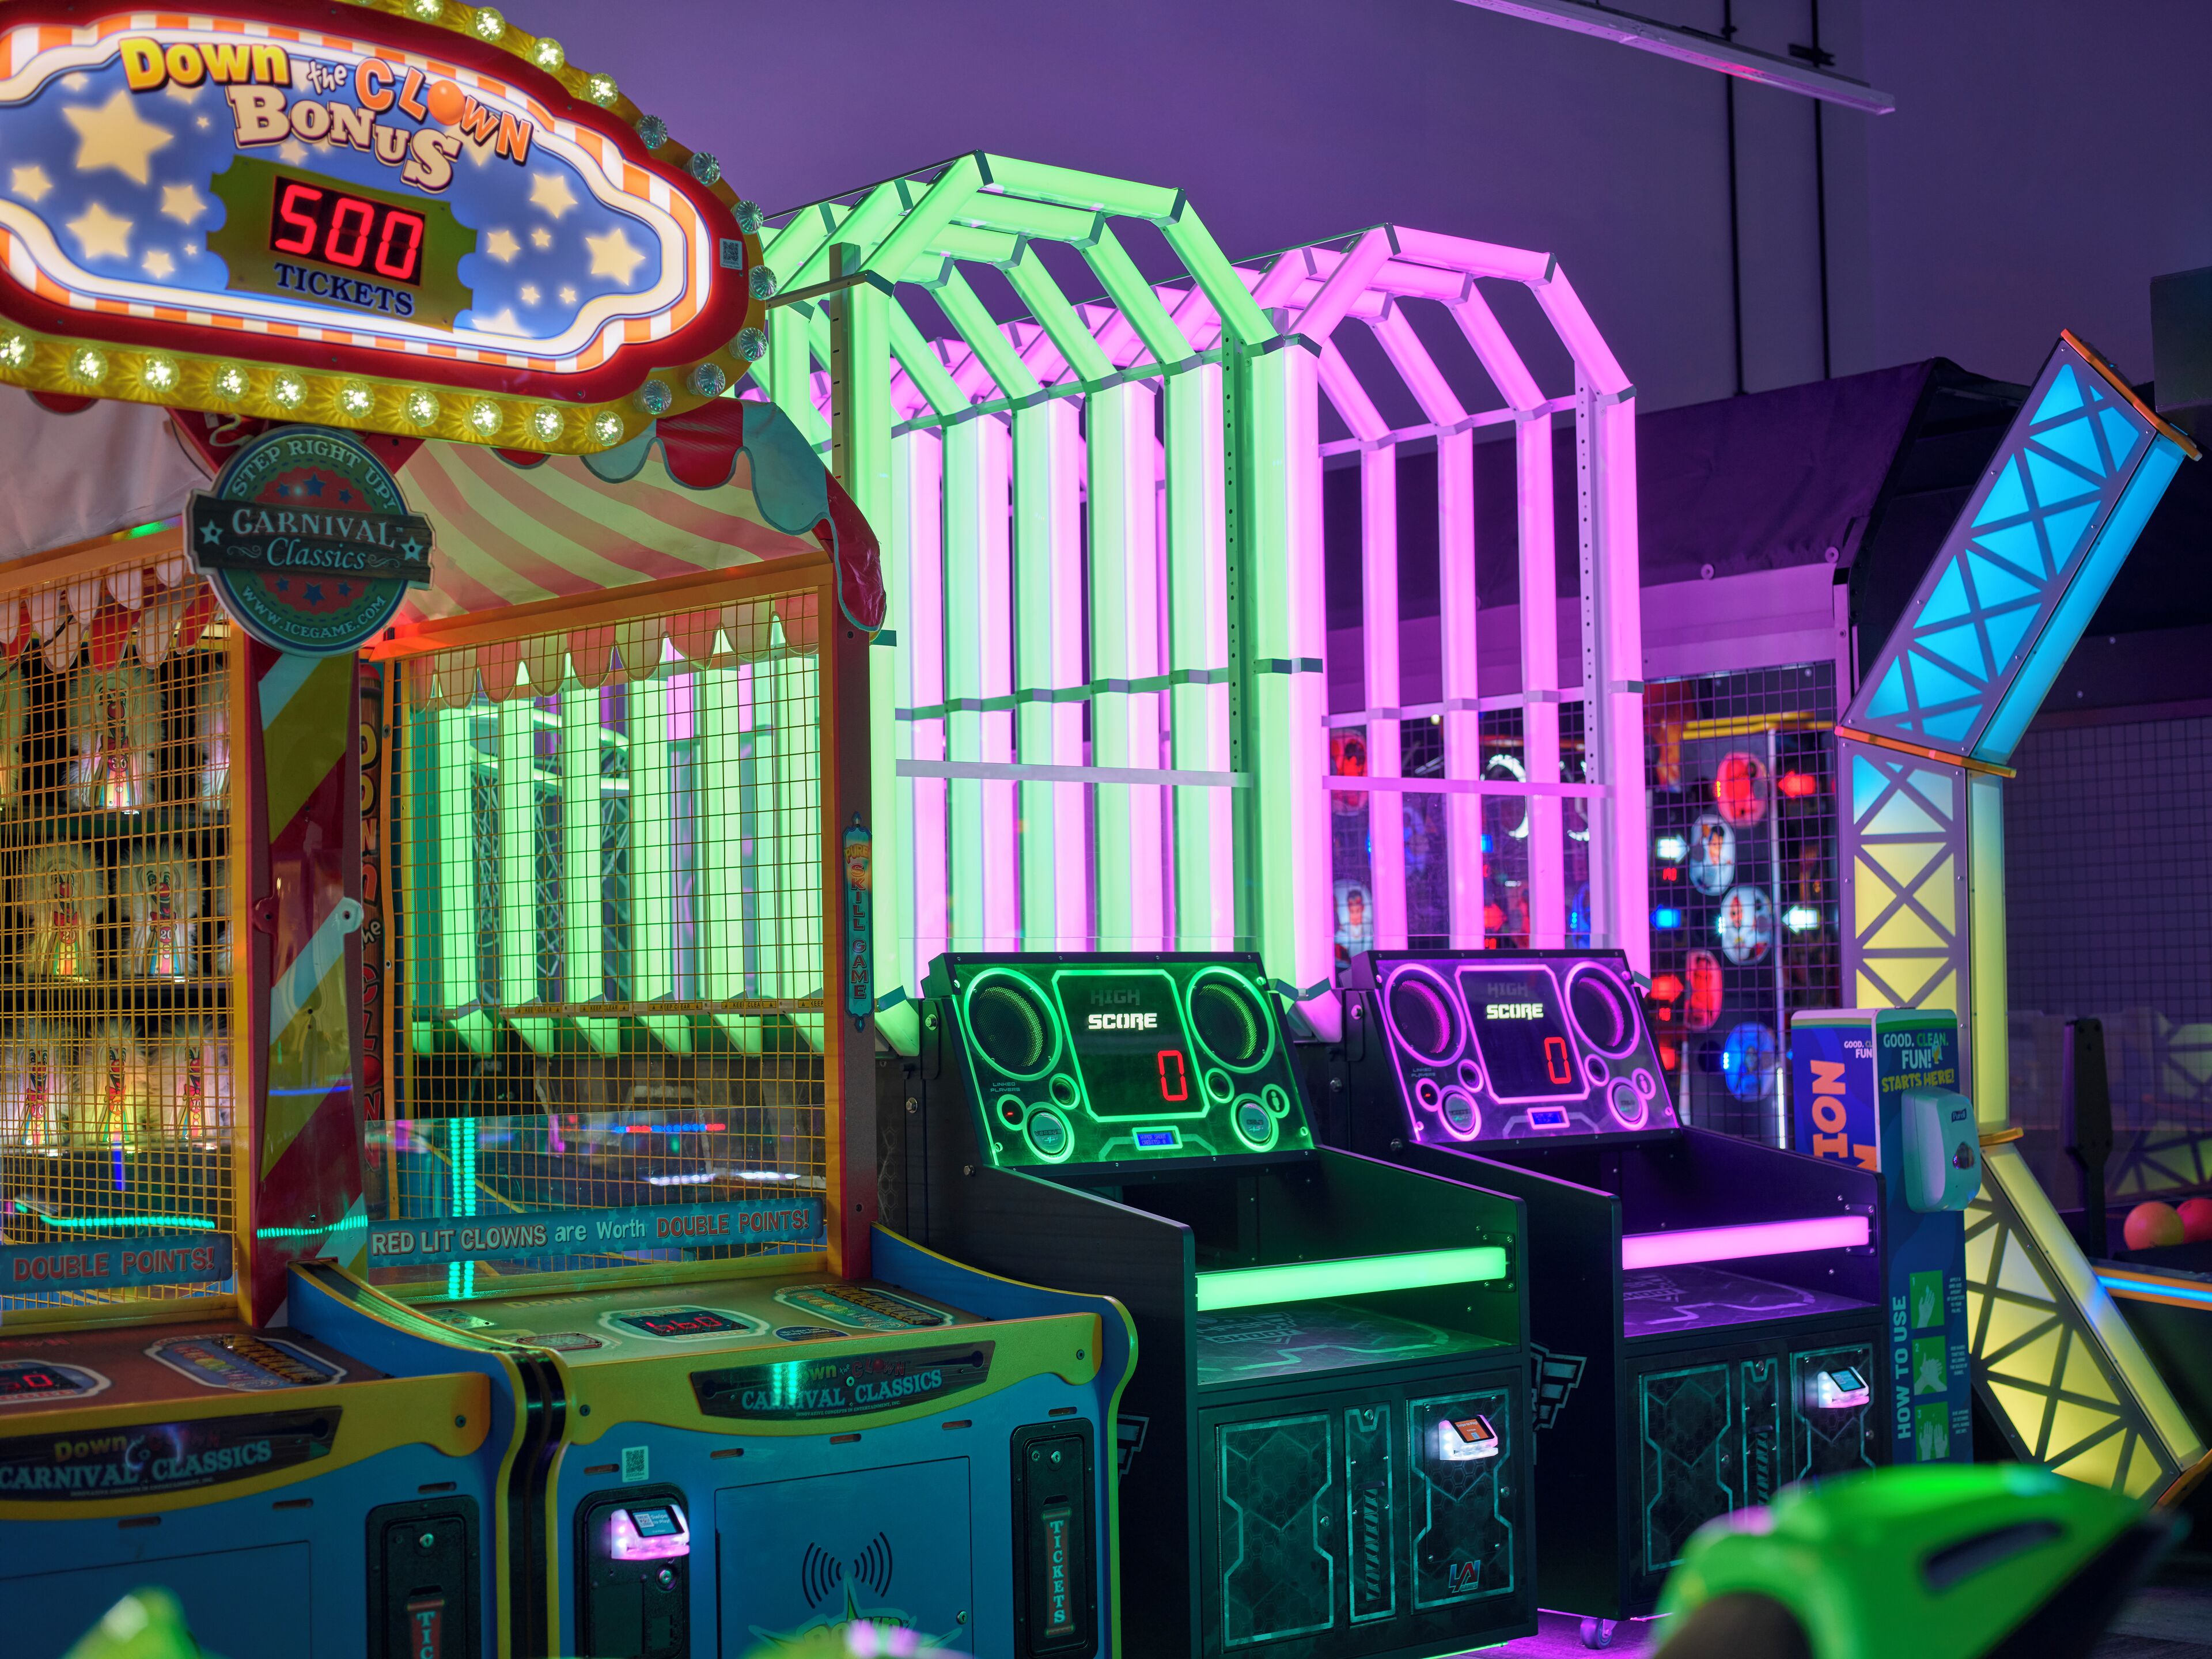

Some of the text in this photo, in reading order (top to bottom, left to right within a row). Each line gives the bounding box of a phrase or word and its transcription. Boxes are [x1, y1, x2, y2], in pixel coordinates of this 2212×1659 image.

[119, 36, 533, 165] Down the CLOWN
[226, 86, 462, 192] BONUS
[275, 184, 424, 280] 500
[274, 263, 414, 316] TICKETS
[232, 440, 396, 509] STEP RIGHT UP!
[232, 509, 395, 548] CARNIVAL
[267, 537, 366, 569] Classics
[242, 585, 386, 639] WWW.ICEGAME.COM
[112, 757, 127, 768] 30
[844, 843, 870, 863] PURE
[62, 929, 75, 941] 20
[160, 929, 172, 940] 20
[362, 917, 382, 952] he
[851, 863, 869, 1000] SKILL GAME
[1090, 989, 1140, 1006] HIGH
[1487, 982, 1529, 998] HIGH
[1088, 1013, 1158, 1031] SCORE
[1486, 1002, 1544, 1020] SCORE
[1844, 1040, 1864, 1048] GOOD.
[1883, 1032, 1949, 1048] GOOD. CLEAN.
[1543, 1036, 1572, 1085] 0
[1855, 1048, 1872, 1058] FUN
[1902, 1049, 1932, 1069] FUN!
[1158, 1050, 1188, 1101] 0
[1881, 1069, 1955, 1093] STARTS HERE!
[33, 1104, 44, 1115] 10
[1034, 1128, 1062, 1137] VERSUS
[371, 1208, 809, 1256] RED LIT CLOWNS are Worth DOUBLE POINTS!
[13, 1247, 214, 1282] DOUBLE POINTS!
[1912, 1277, 1915, 1286] 1
[502, 1296, 594, 1309] Down
[1915, 1343, 1919, 1352] 2
[839, 1363, 851, 1375] the
[1892, 1296, 1911, 1440] HOW TO USE
[855, 1369, 943, 1404] CLASSICS
[1917, 1409, 1922, 1419] 3
[54, 1435, 127, 1463] Down
[0, 1440, 272, 1490] CARNIVAL CLASSICS
[1047, 1519, 1066, 1626] TICKETS
